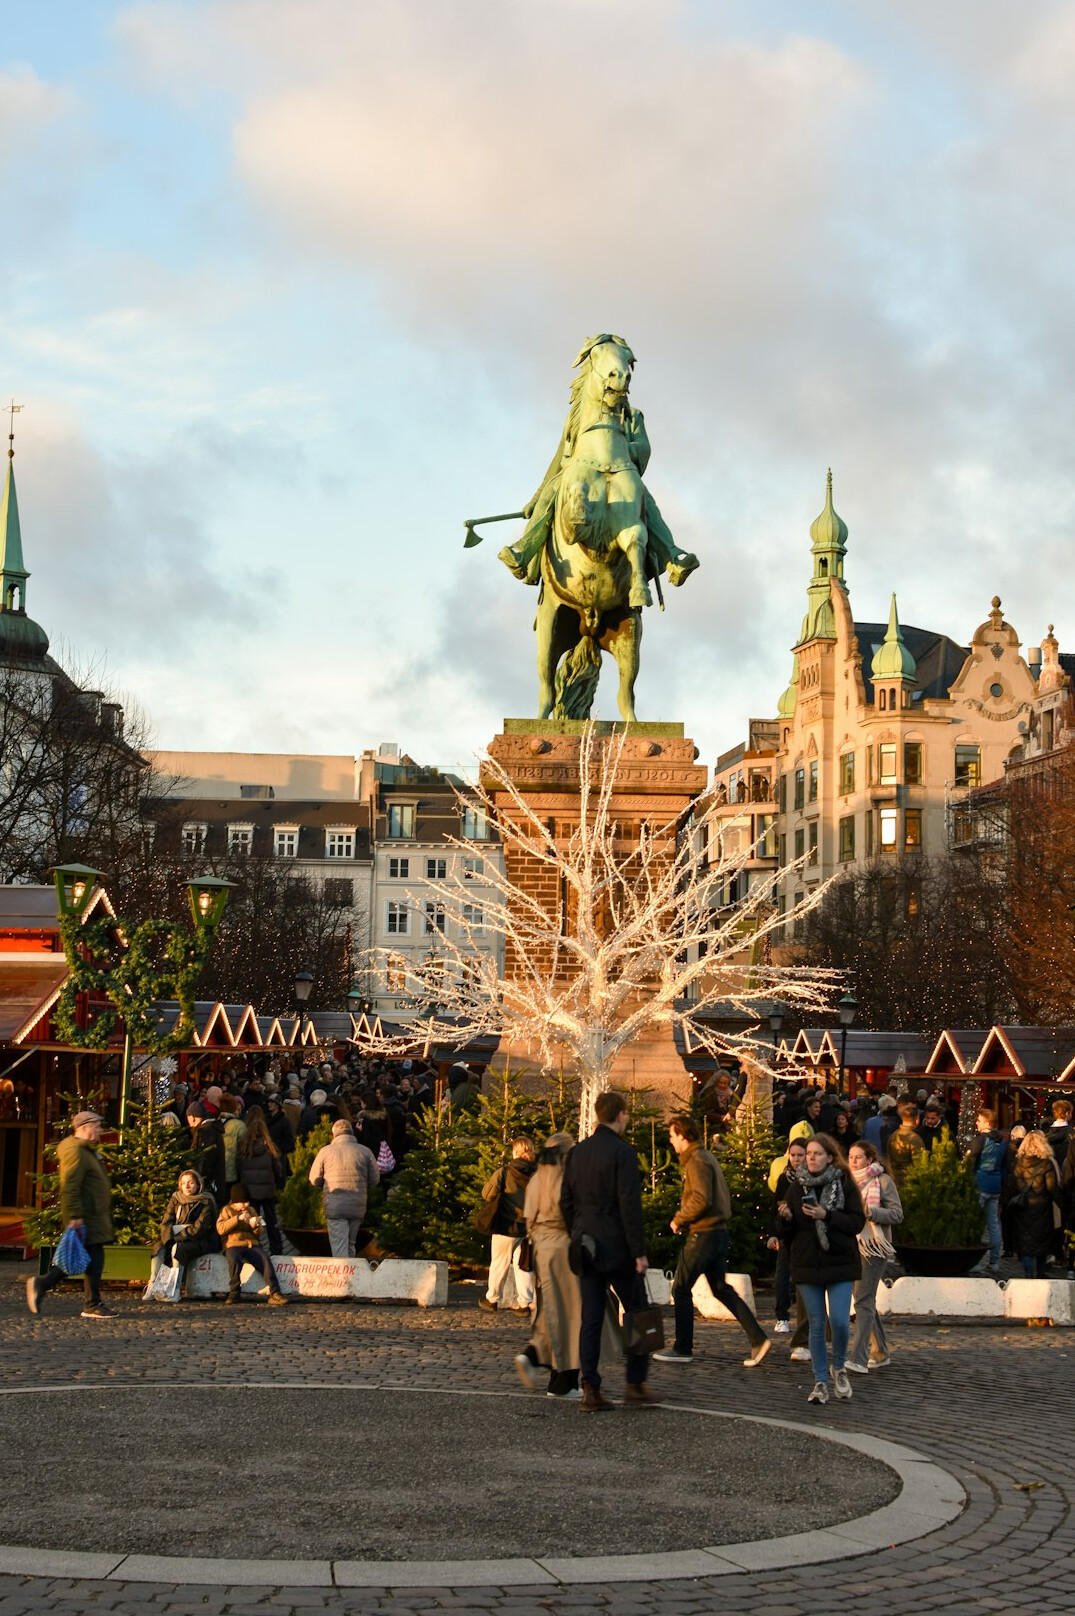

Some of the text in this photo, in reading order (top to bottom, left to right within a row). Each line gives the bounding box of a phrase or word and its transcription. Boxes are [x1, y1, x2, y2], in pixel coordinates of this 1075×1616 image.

[515, 767, 675, 780] 1128 ABAON 1201
